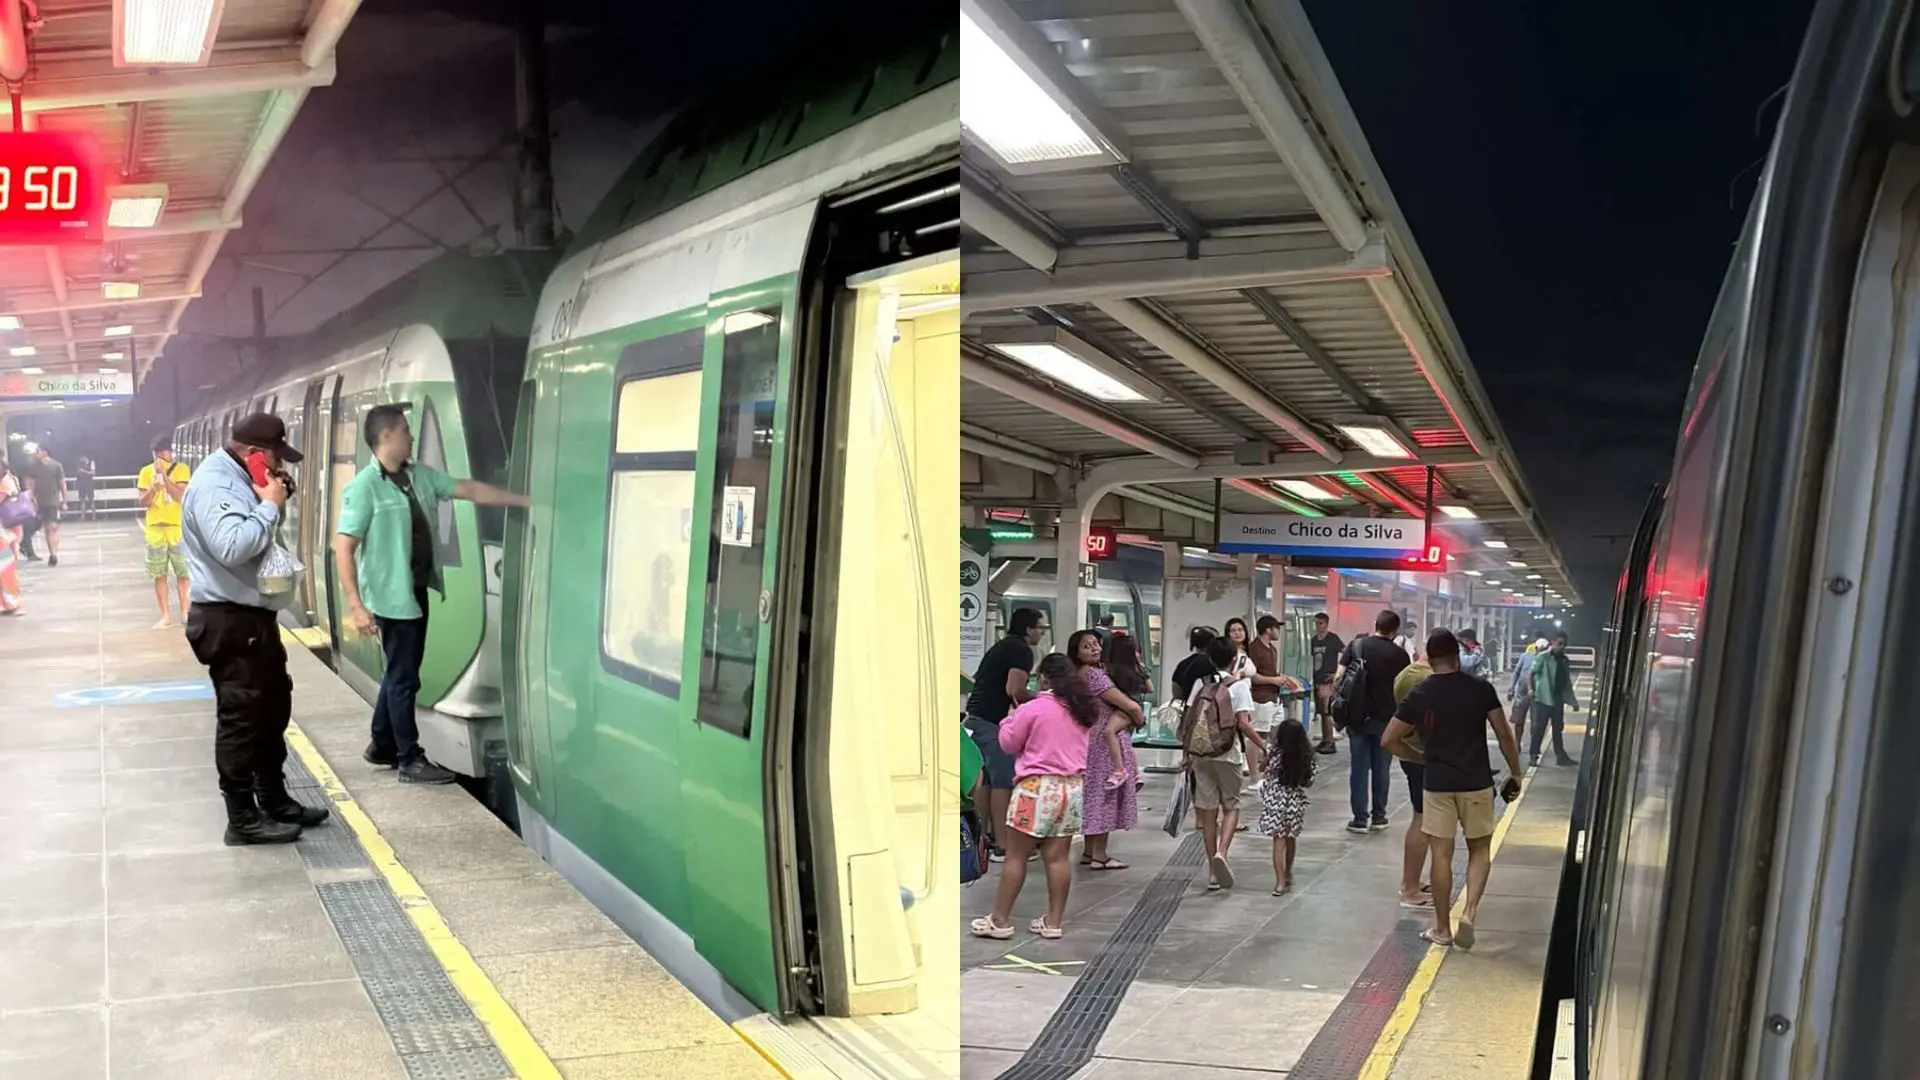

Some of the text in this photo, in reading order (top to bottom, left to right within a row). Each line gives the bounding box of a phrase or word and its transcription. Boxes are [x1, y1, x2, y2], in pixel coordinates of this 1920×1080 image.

[38, 380, 116, 392] Chico da Silva
[1242, 521, 1402, 540] Destino Chico da Silva
[1087, 535, 1106, 551] 50
